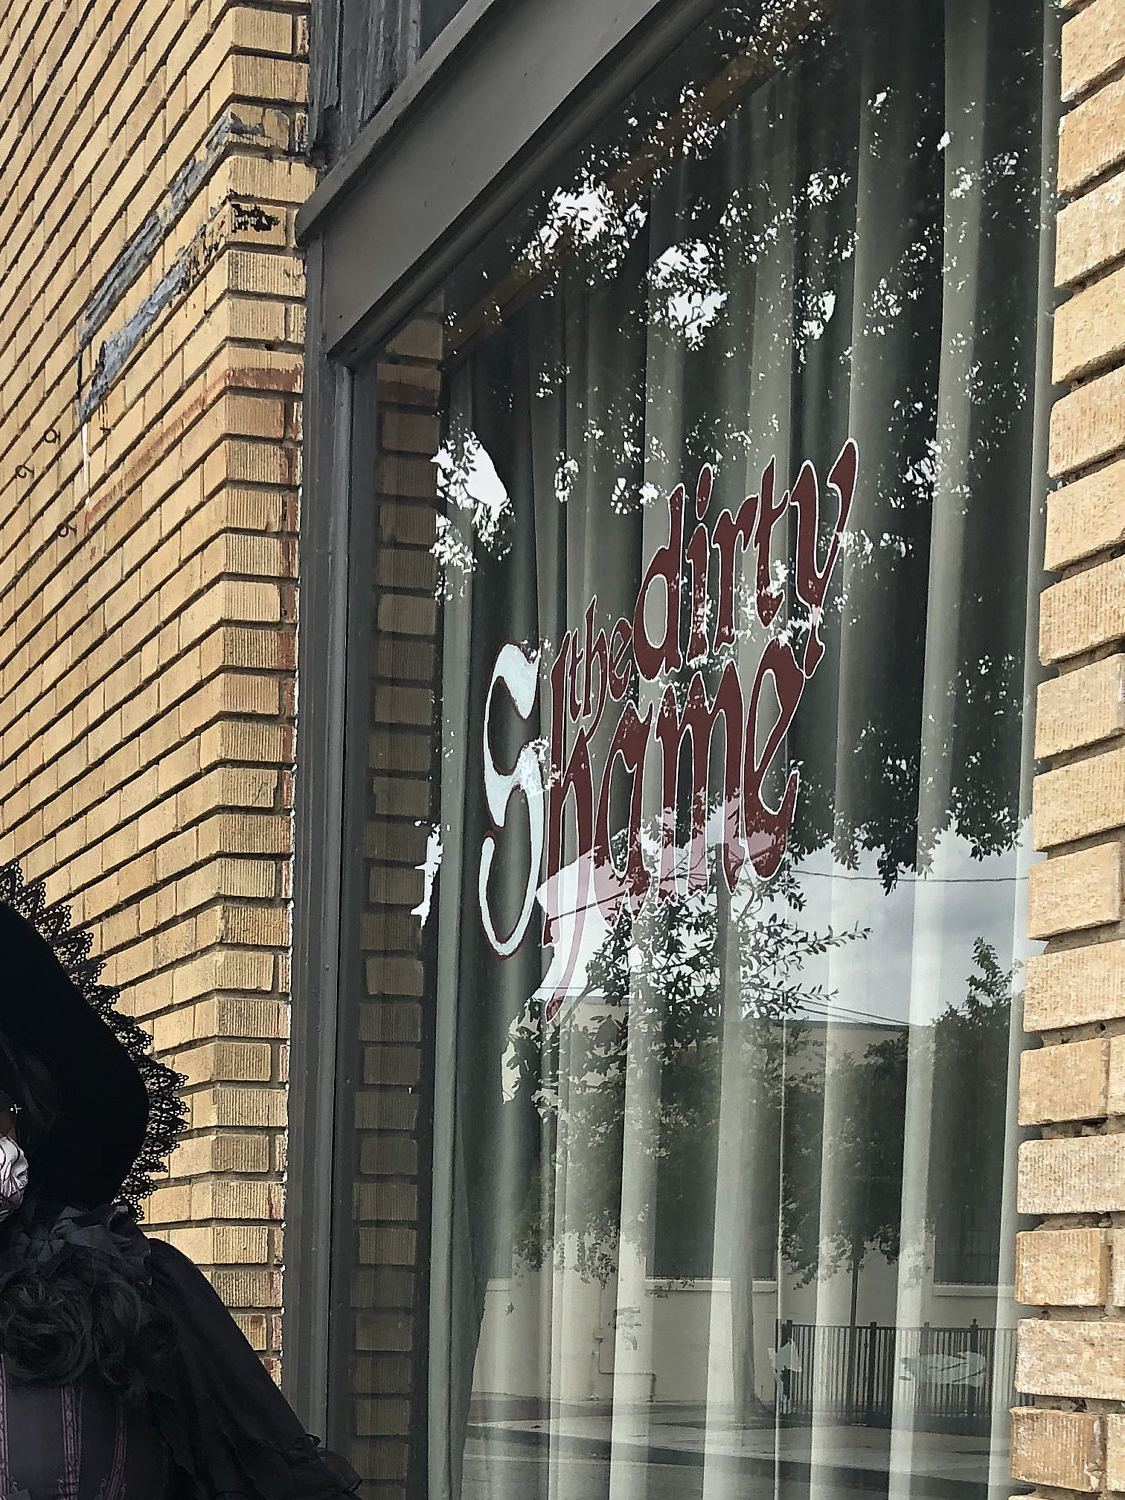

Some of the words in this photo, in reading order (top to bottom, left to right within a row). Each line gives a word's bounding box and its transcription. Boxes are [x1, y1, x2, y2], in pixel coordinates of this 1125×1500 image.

[567, 594, 633, 724] the
[632, 437, 858, 682] dirty
[479, 629, 800, 1024] Shame
